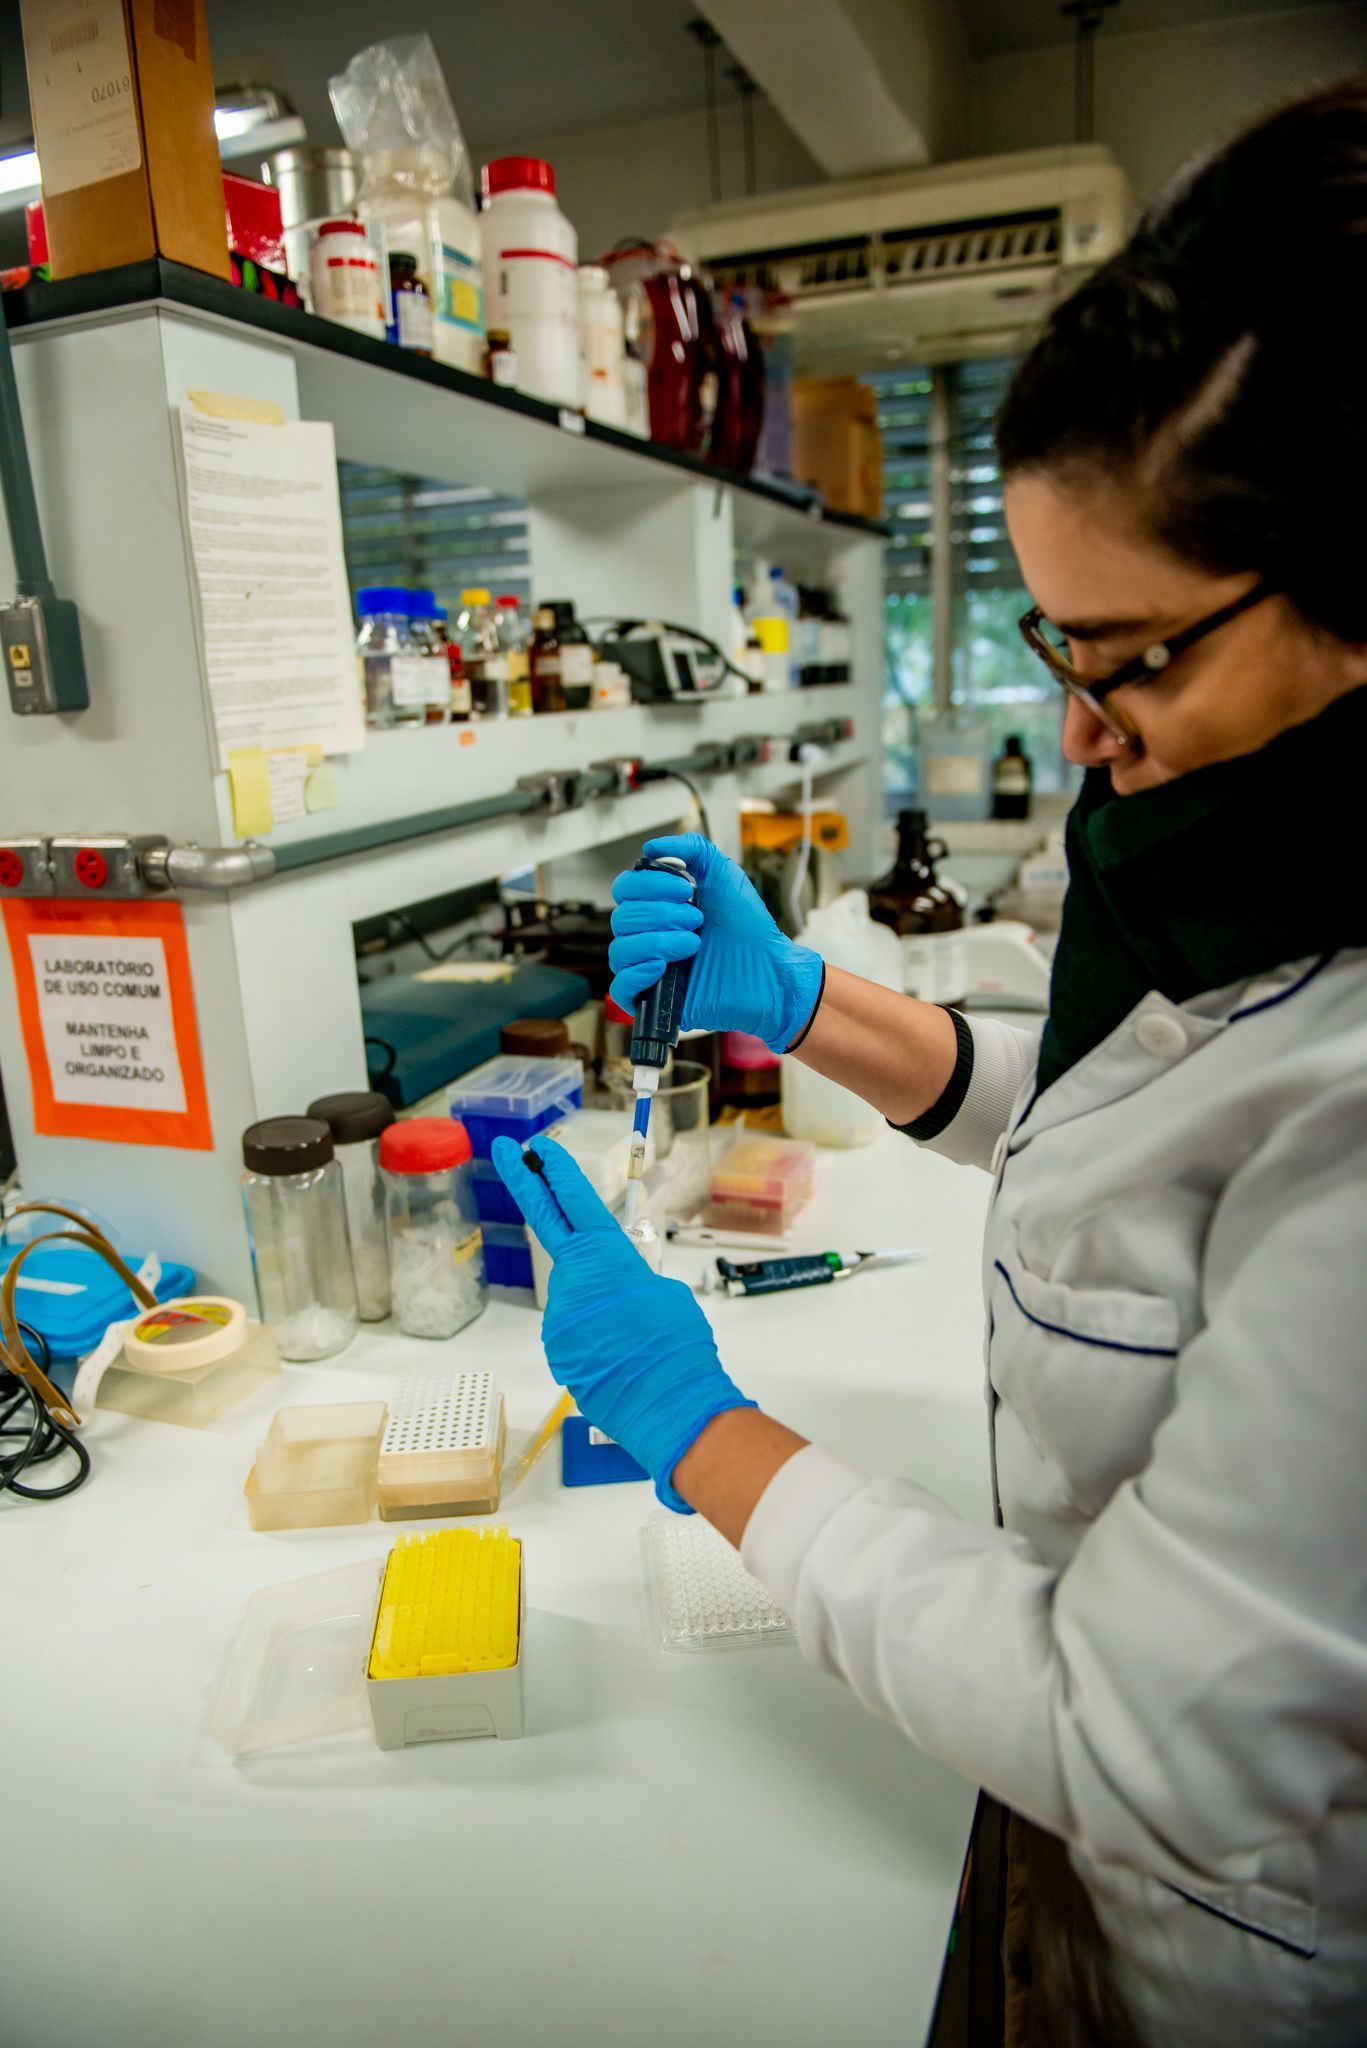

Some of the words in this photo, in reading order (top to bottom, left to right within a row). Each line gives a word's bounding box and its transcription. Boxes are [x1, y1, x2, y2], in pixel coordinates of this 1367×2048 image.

[91, 75, 131, 103] 61070
[44, 958, 154, 976] LABORATÓRIO
[44, 980, 61, 995] DE
[67, 981, 98, 996] USO
[103, 982, 161, 998] COMUM
[66, 1022, 149, 1039] MANTENHA
[81, 1044, 127, 1059] LIMPO
[131, 1046, 141, 1060] E
[65, 1061, 164, 1082] ORGANIZADO
